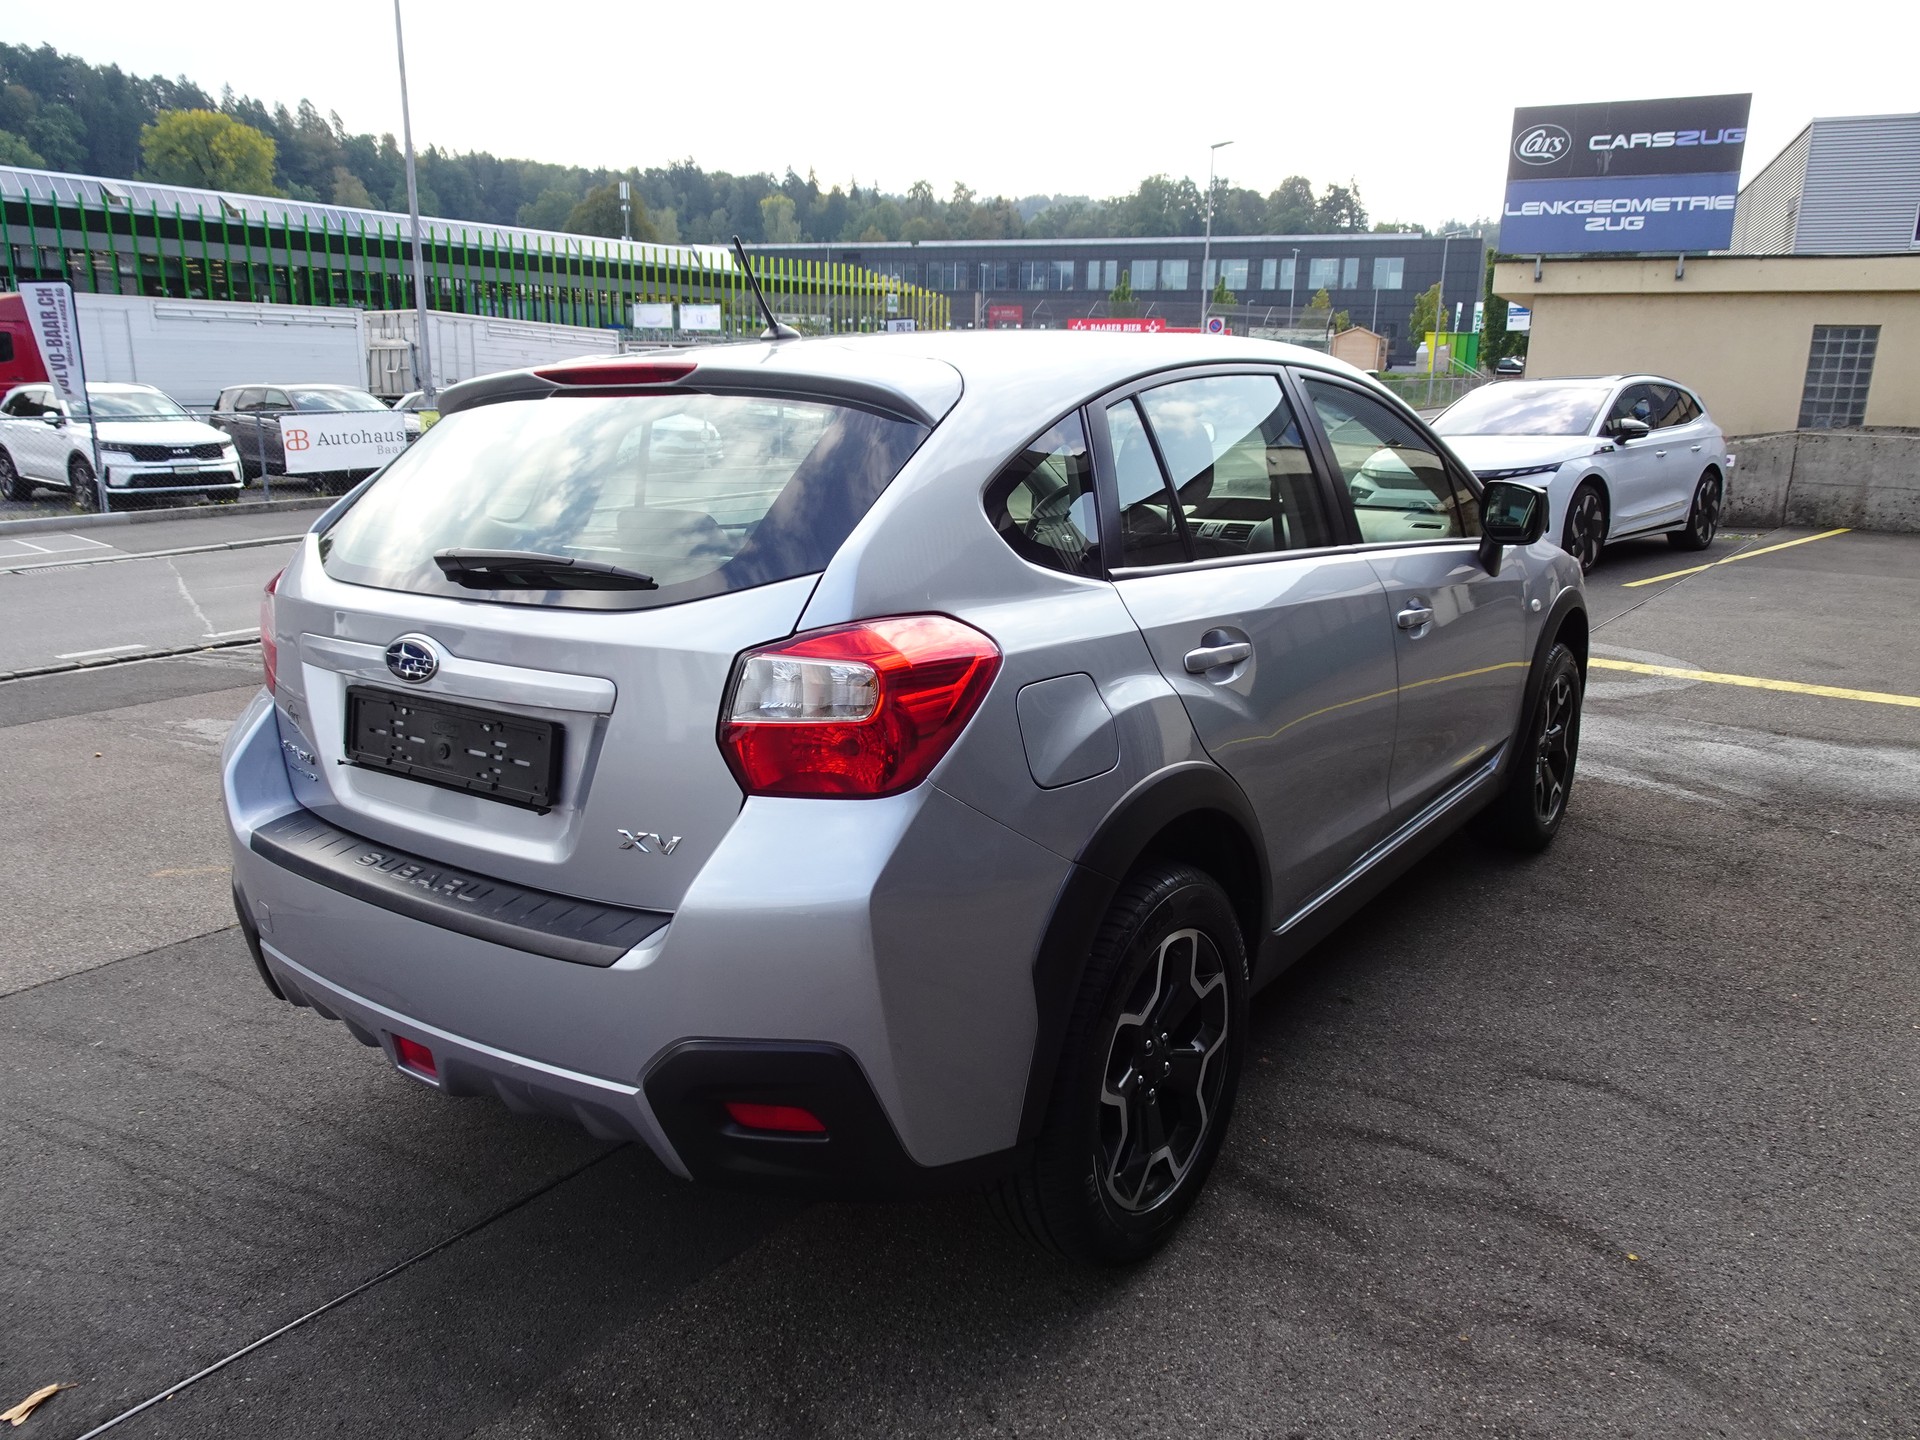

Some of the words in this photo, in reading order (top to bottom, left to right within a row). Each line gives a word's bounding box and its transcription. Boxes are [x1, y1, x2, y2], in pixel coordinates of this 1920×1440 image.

[1519, 129, 1565, 159] Cars
[1588, 128, 1747, 151] CARSZUG
[1504, 195, 1736, 217] LENKGEOMETRIE
[1584, 216, 1645, 232] ZUG
[1123, 323, 1141, 332] BIER
[35, 287, 72, 395] VOLVO-BAAR.CH
[317, 429, 404, 446] Autohaus
[617, 828, 683, 855] XV
[353, 851, 495, 902] SUBARU
